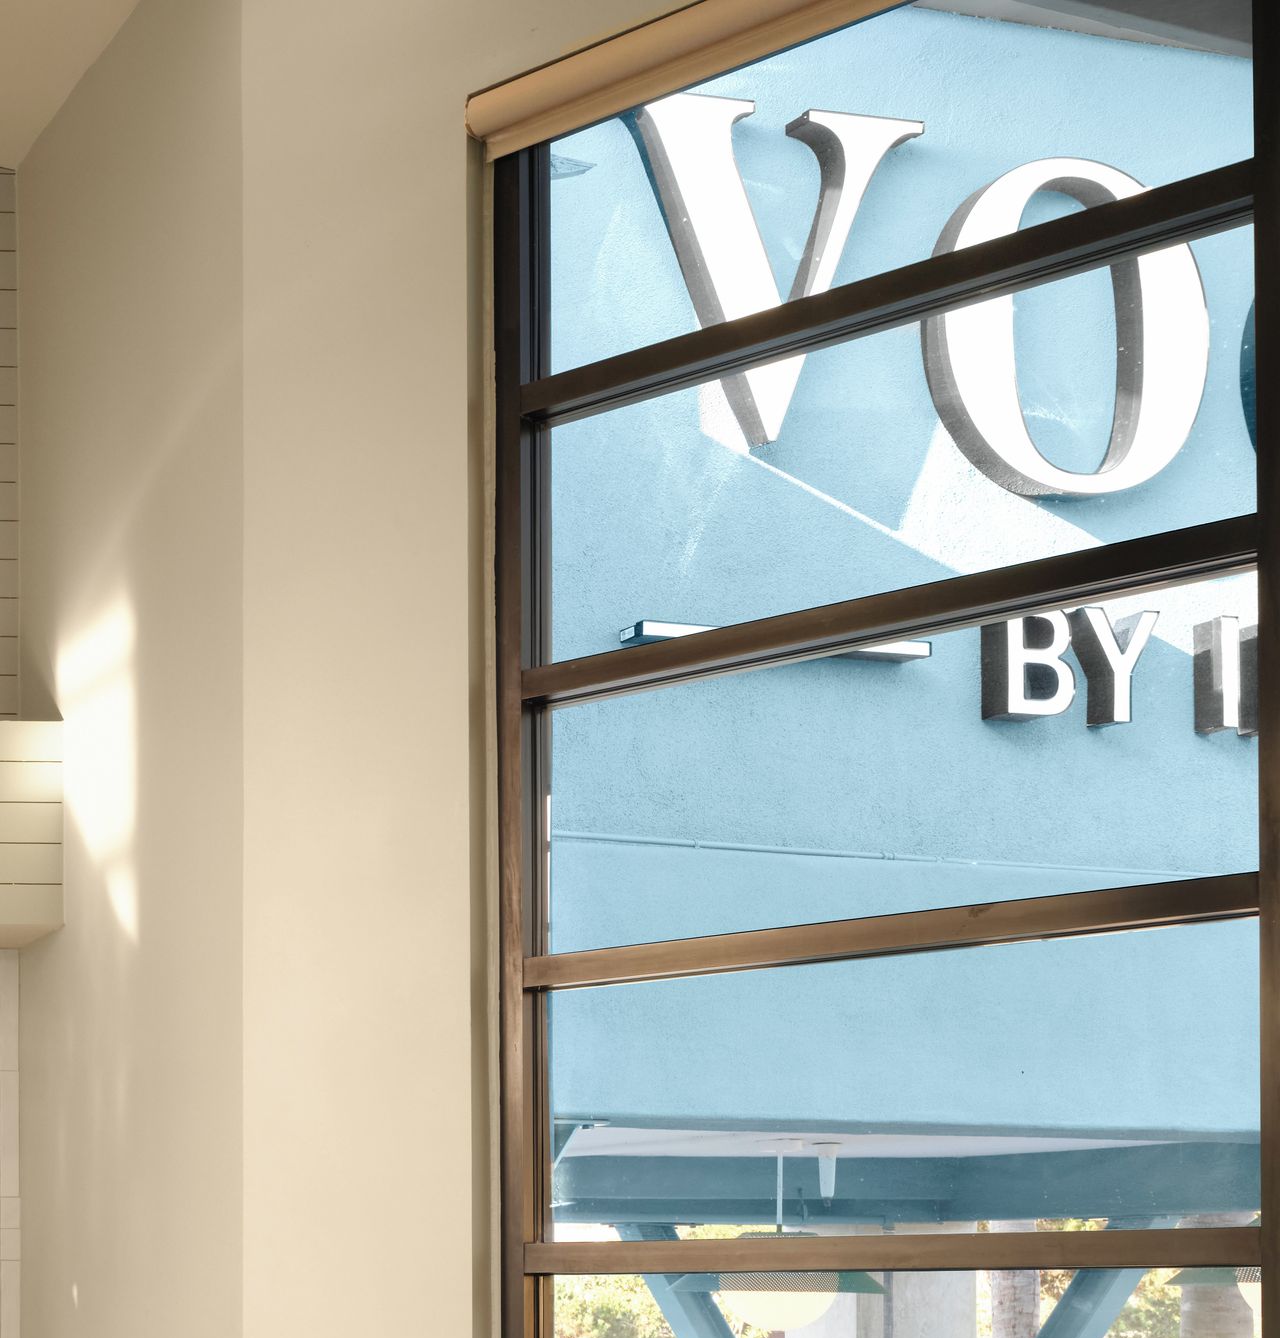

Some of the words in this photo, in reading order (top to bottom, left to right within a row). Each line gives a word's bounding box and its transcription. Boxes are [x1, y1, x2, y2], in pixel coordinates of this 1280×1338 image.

[622, 92, 1258, 496] VO
[981, 606, 1160, 727] BY
[1193, 615, 1258, 735] I
